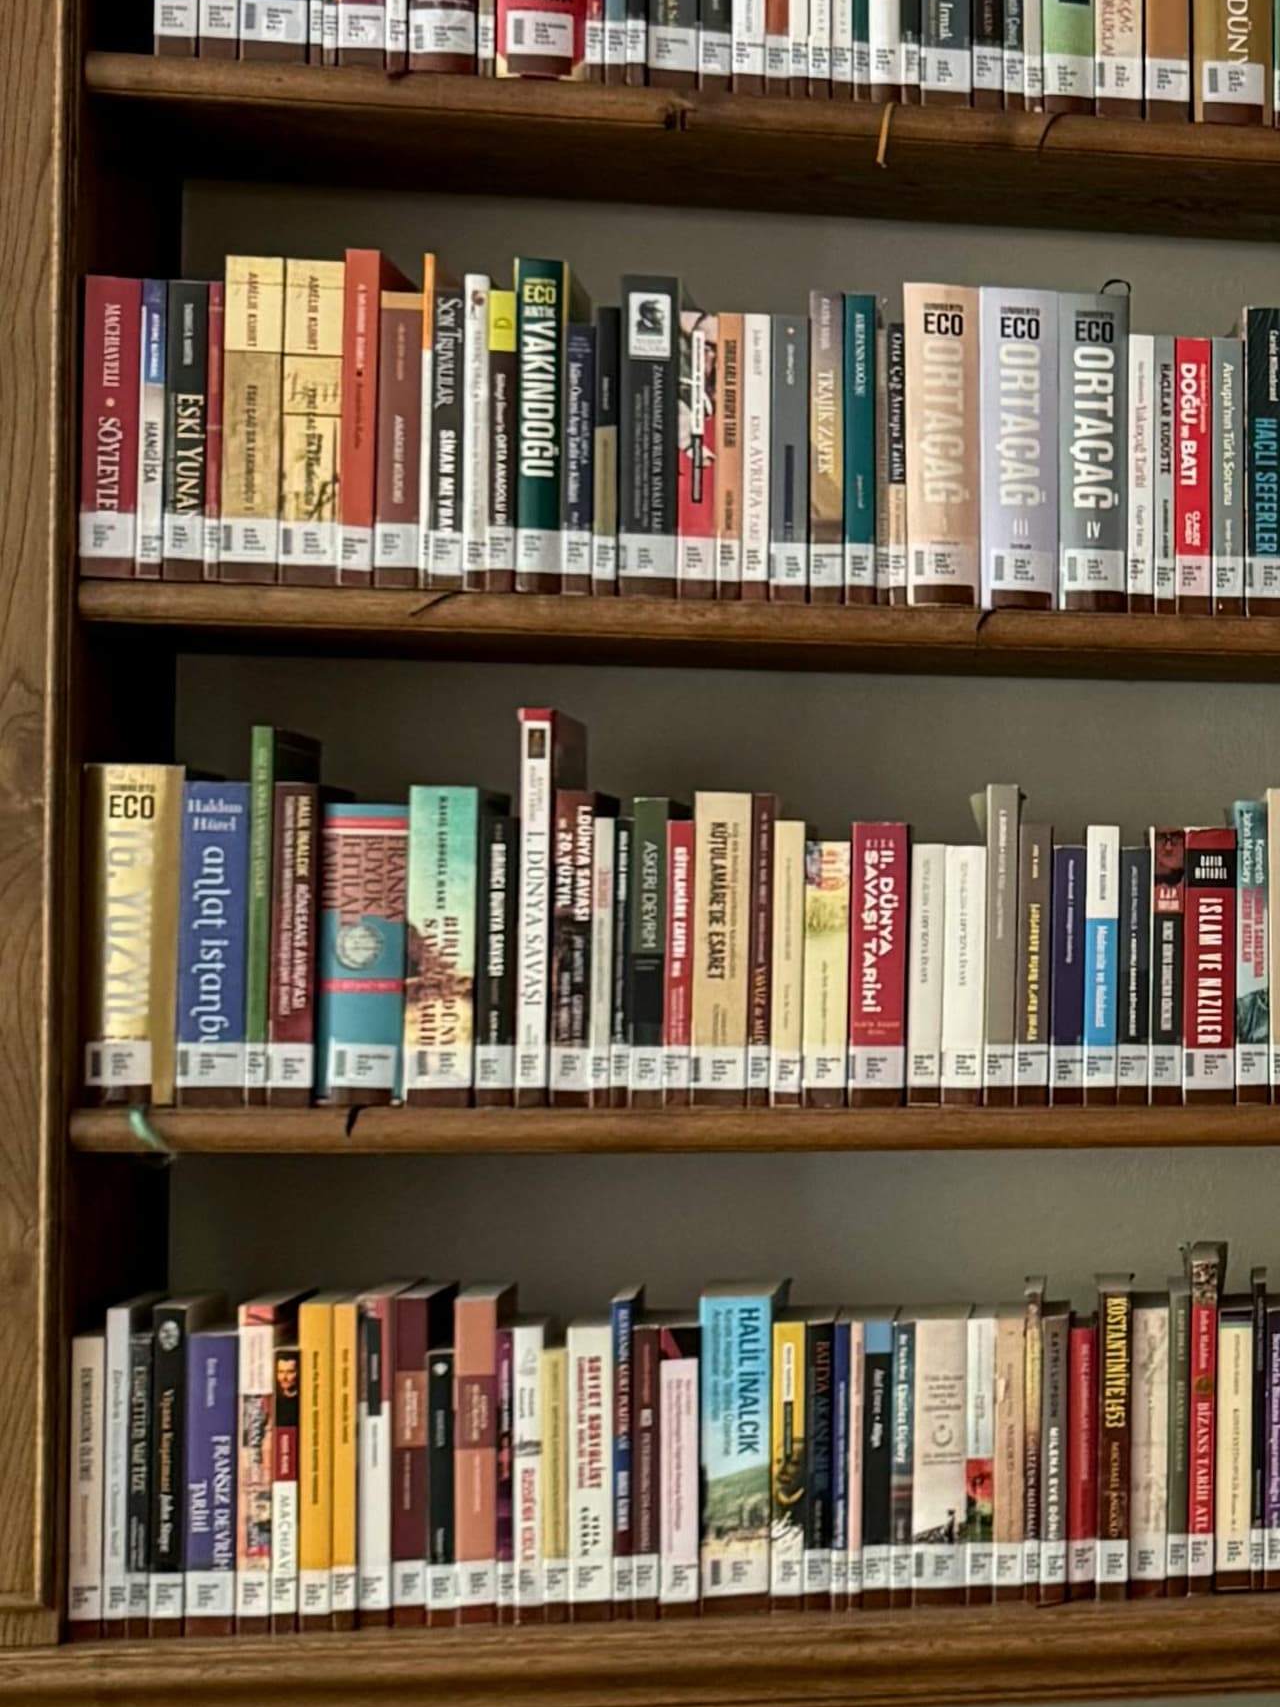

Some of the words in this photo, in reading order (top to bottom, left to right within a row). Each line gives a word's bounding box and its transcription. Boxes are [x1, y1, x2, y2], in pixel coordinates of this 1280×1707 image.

[523, 284, 556, 304] ECO
[923, 312, 964, 338] ECO
[1000, 313, 1041, 341] ECO
[1074, 317, 1115, 345] ECO
[520, 321, 556, 480] YAKINDOĞU
[1180, 363, 1198, 423] DOĞU
[1221, 362, 1235, 423] Avrupa'nın
[919, 336, 967, 507] ORTAÇAĞ
[997, 342, 1044, 508] ORTAÇAĞ
[1072, 343, 1116, 513] ORTAÇAĞ
[1222, 425, 1235, 458] Türk
[1255, 417, 1279, 468] HAÇLI
[1180, 438, 1198, 487] BATI
[1222, 461, 1234, 507] Sorunu
[1255, 471, 1279, 555] SEFERLER
[108, 794, 156, 820] ECO
[187, 798, 243, 814] Haldun
[1200, 854, 1225, 867] DAVID
[863, 848, 881, 933] SAVAŞI
[1198, 897, 1224, 948] İSLAM
[861, 939, 882, 1014] TARİHİ
[1198, 952, 1223, 977] VE
[1196, 980, 1224, 1047] NAZİLER
[738, 1306, 761, 1355] HALİL
[737, 1358, 761, 1457] İNALCIK
